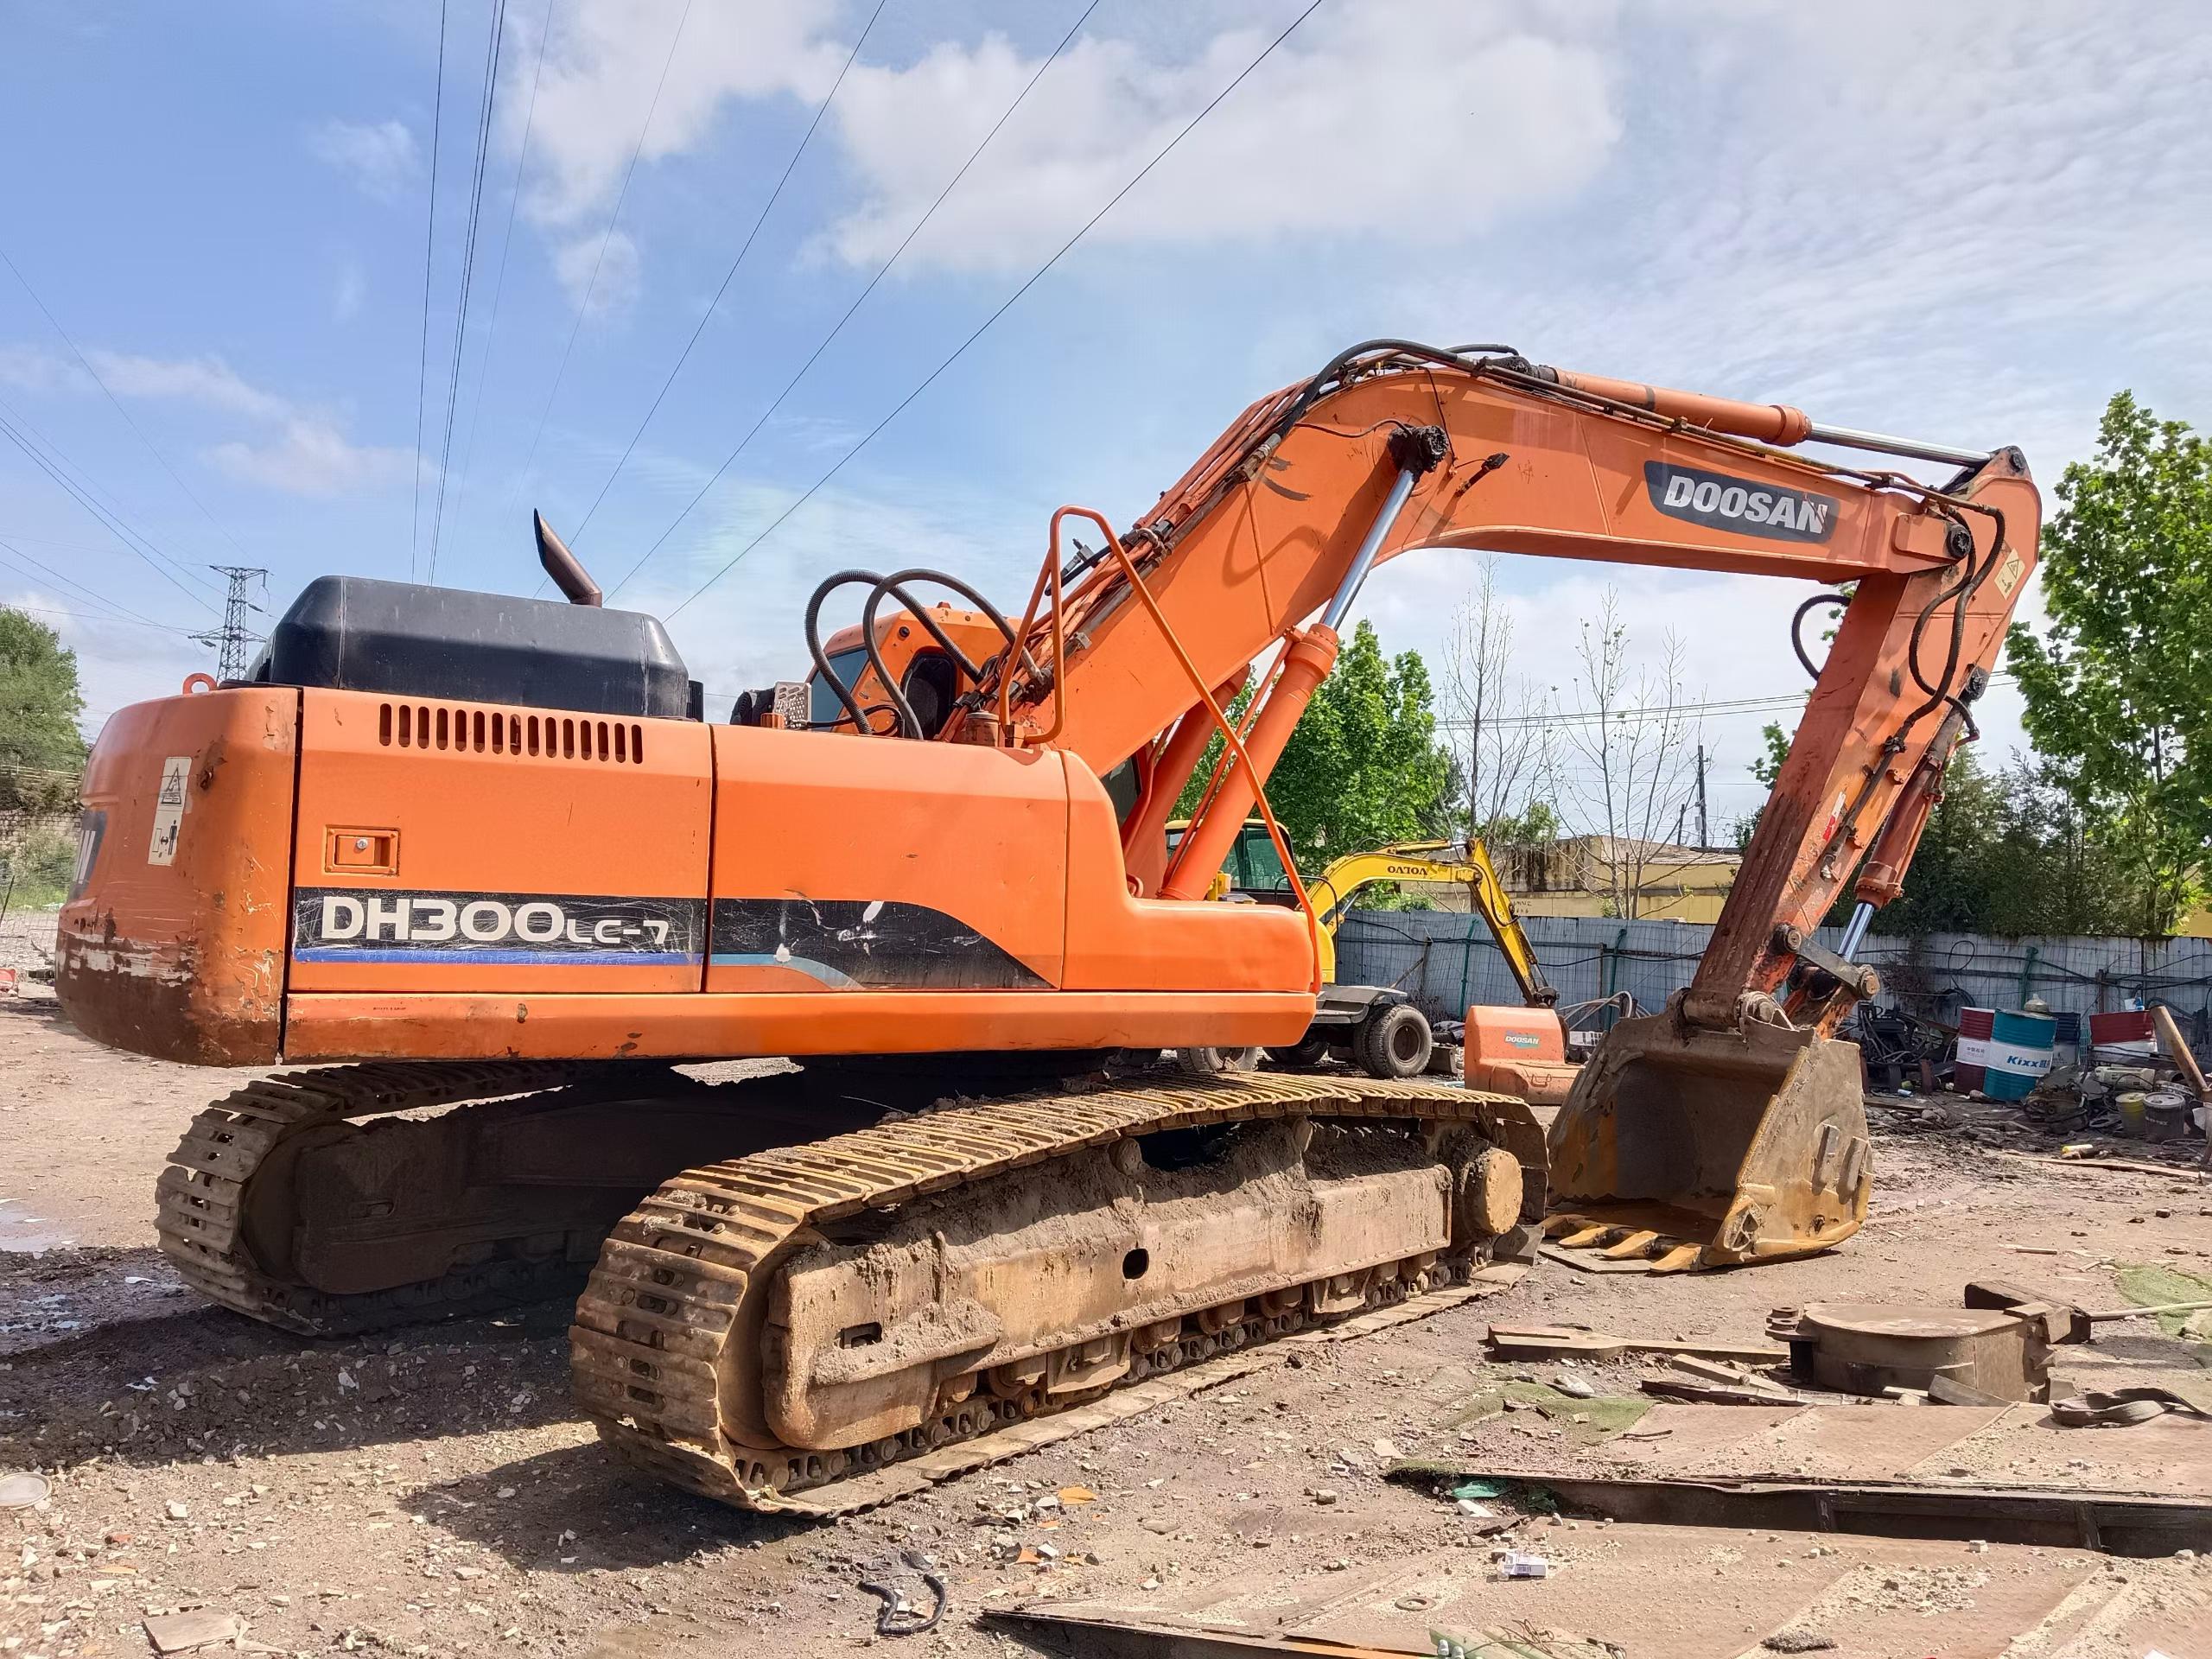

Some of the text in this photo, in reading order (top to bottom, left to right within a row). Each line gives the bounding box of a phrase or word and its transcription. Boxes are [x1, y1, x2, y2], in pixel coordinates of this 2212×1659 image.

[1663, 474, 1829, 534] DOOSAN
[1387, 865, 1427, 875] VOLVO
[1504, 1035, 1540, 1045] DOOSAN
